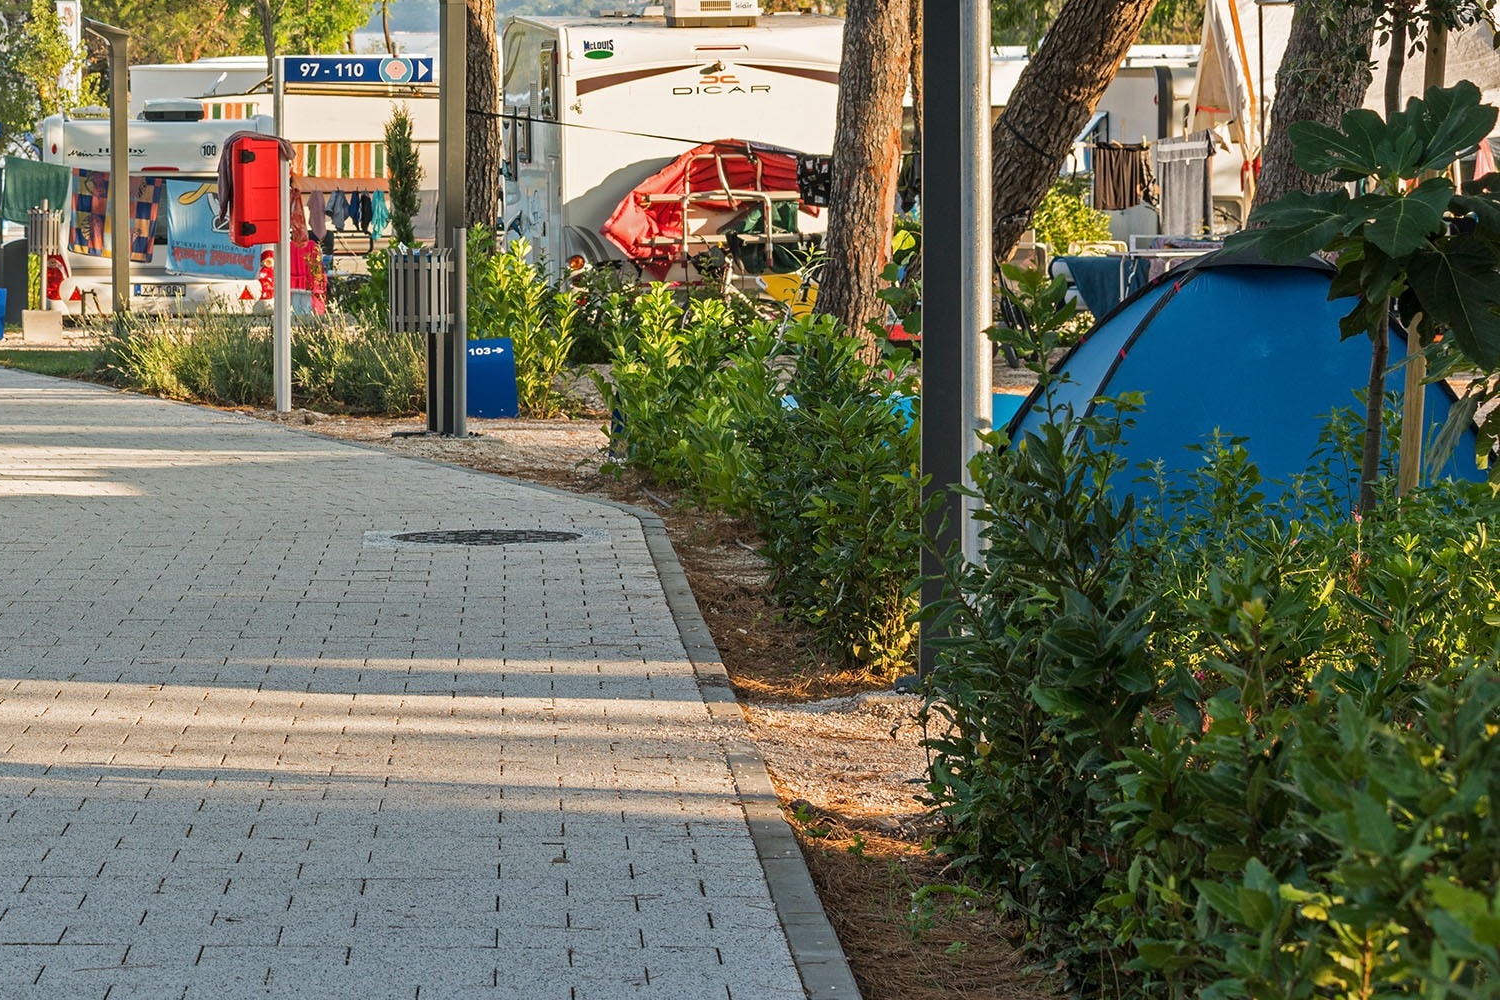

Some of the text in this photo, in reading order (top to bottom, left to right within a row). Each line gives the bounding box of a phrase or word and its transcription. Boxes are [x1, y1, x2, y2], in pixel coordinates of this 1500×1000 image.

[300, 63, 320, 77] 97
[335, 63, 364, 77] 110
[672, 85, 771, 95] DICAR
[201, 144, 216, 156] 100
[468, 347, 491, 356] 103
